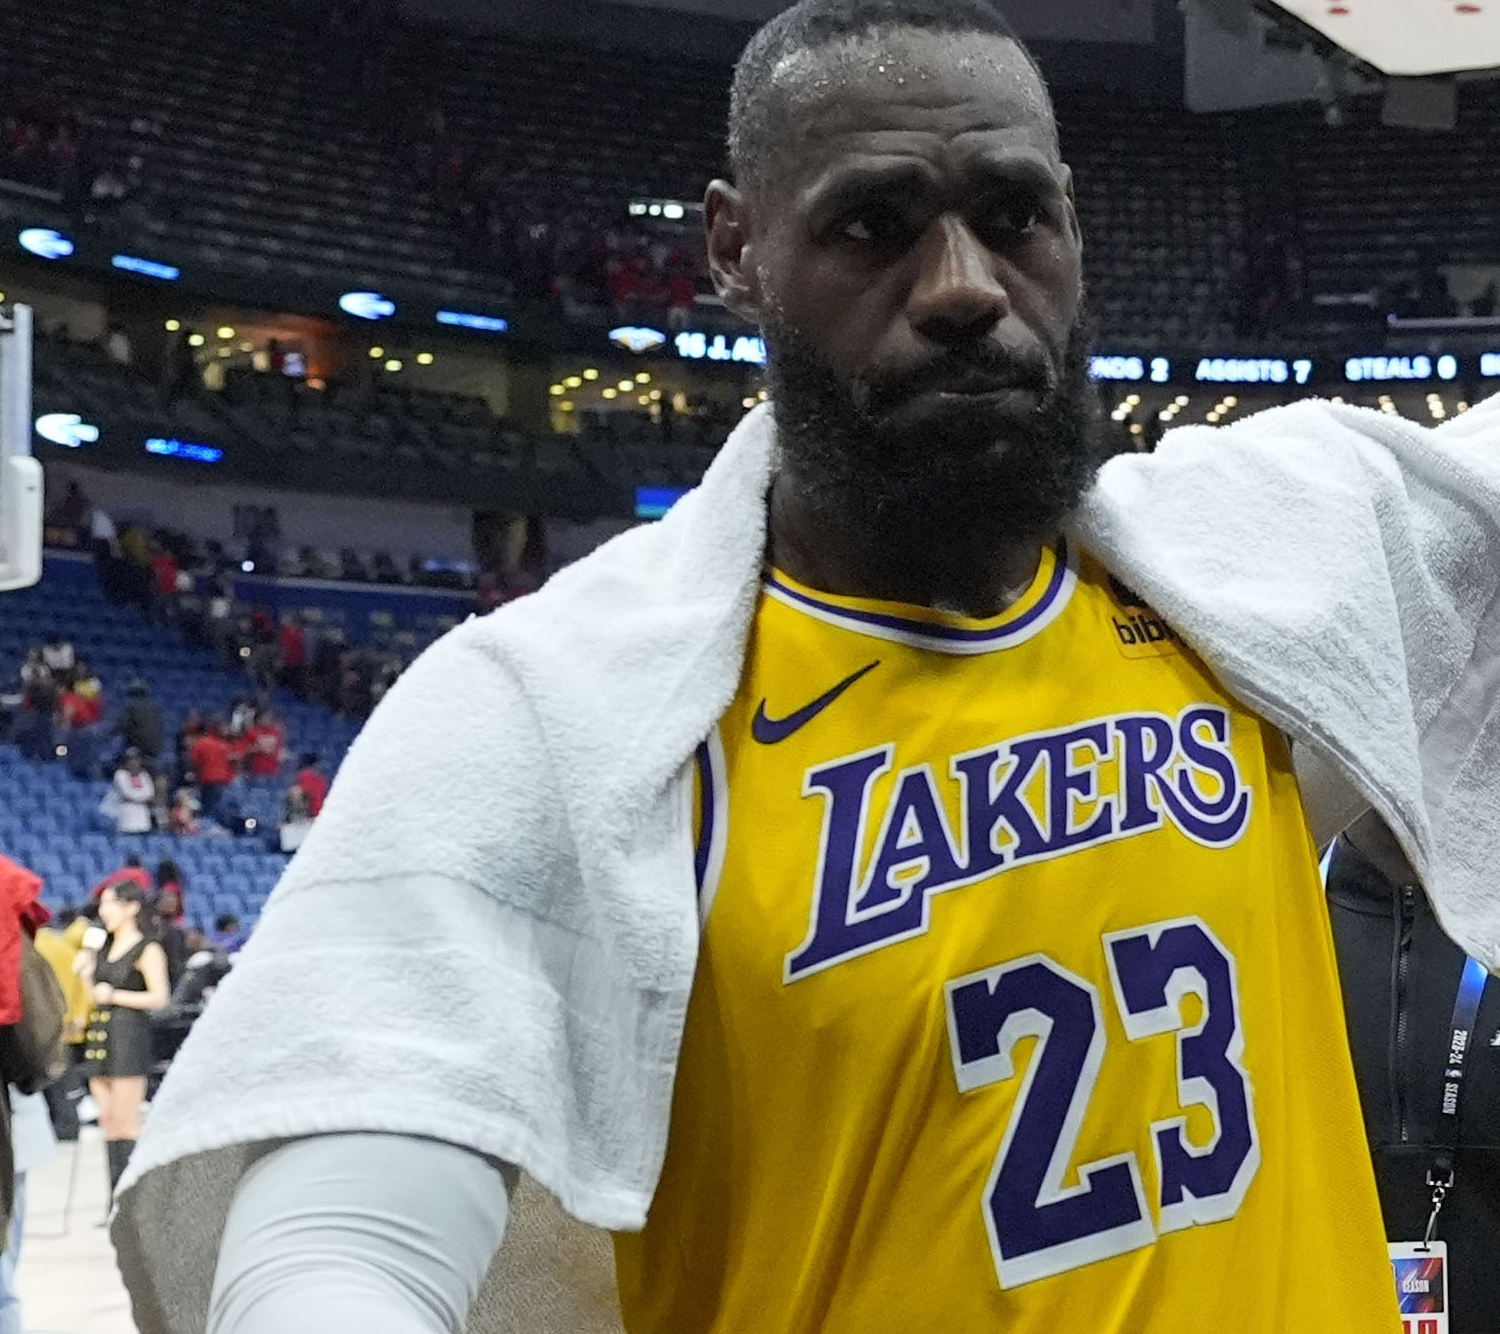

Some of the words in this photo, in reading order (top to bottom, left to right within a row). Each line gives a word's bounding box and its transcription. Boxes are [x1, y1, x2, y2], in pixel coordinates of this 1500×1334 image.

[1195, 357, 1290, 383] ASSISTS
[1344, 355, 1433, 383] STEALS
[782, 702, 1255, 986] LAKERS
[1448, 1029, 1469, 1066] 2023-24
[942, 915, 1263, 1292] 23
[1441, 1082, 1460, 1116] SEASON
[1401, 1278, 1431, 1295] SEASON
